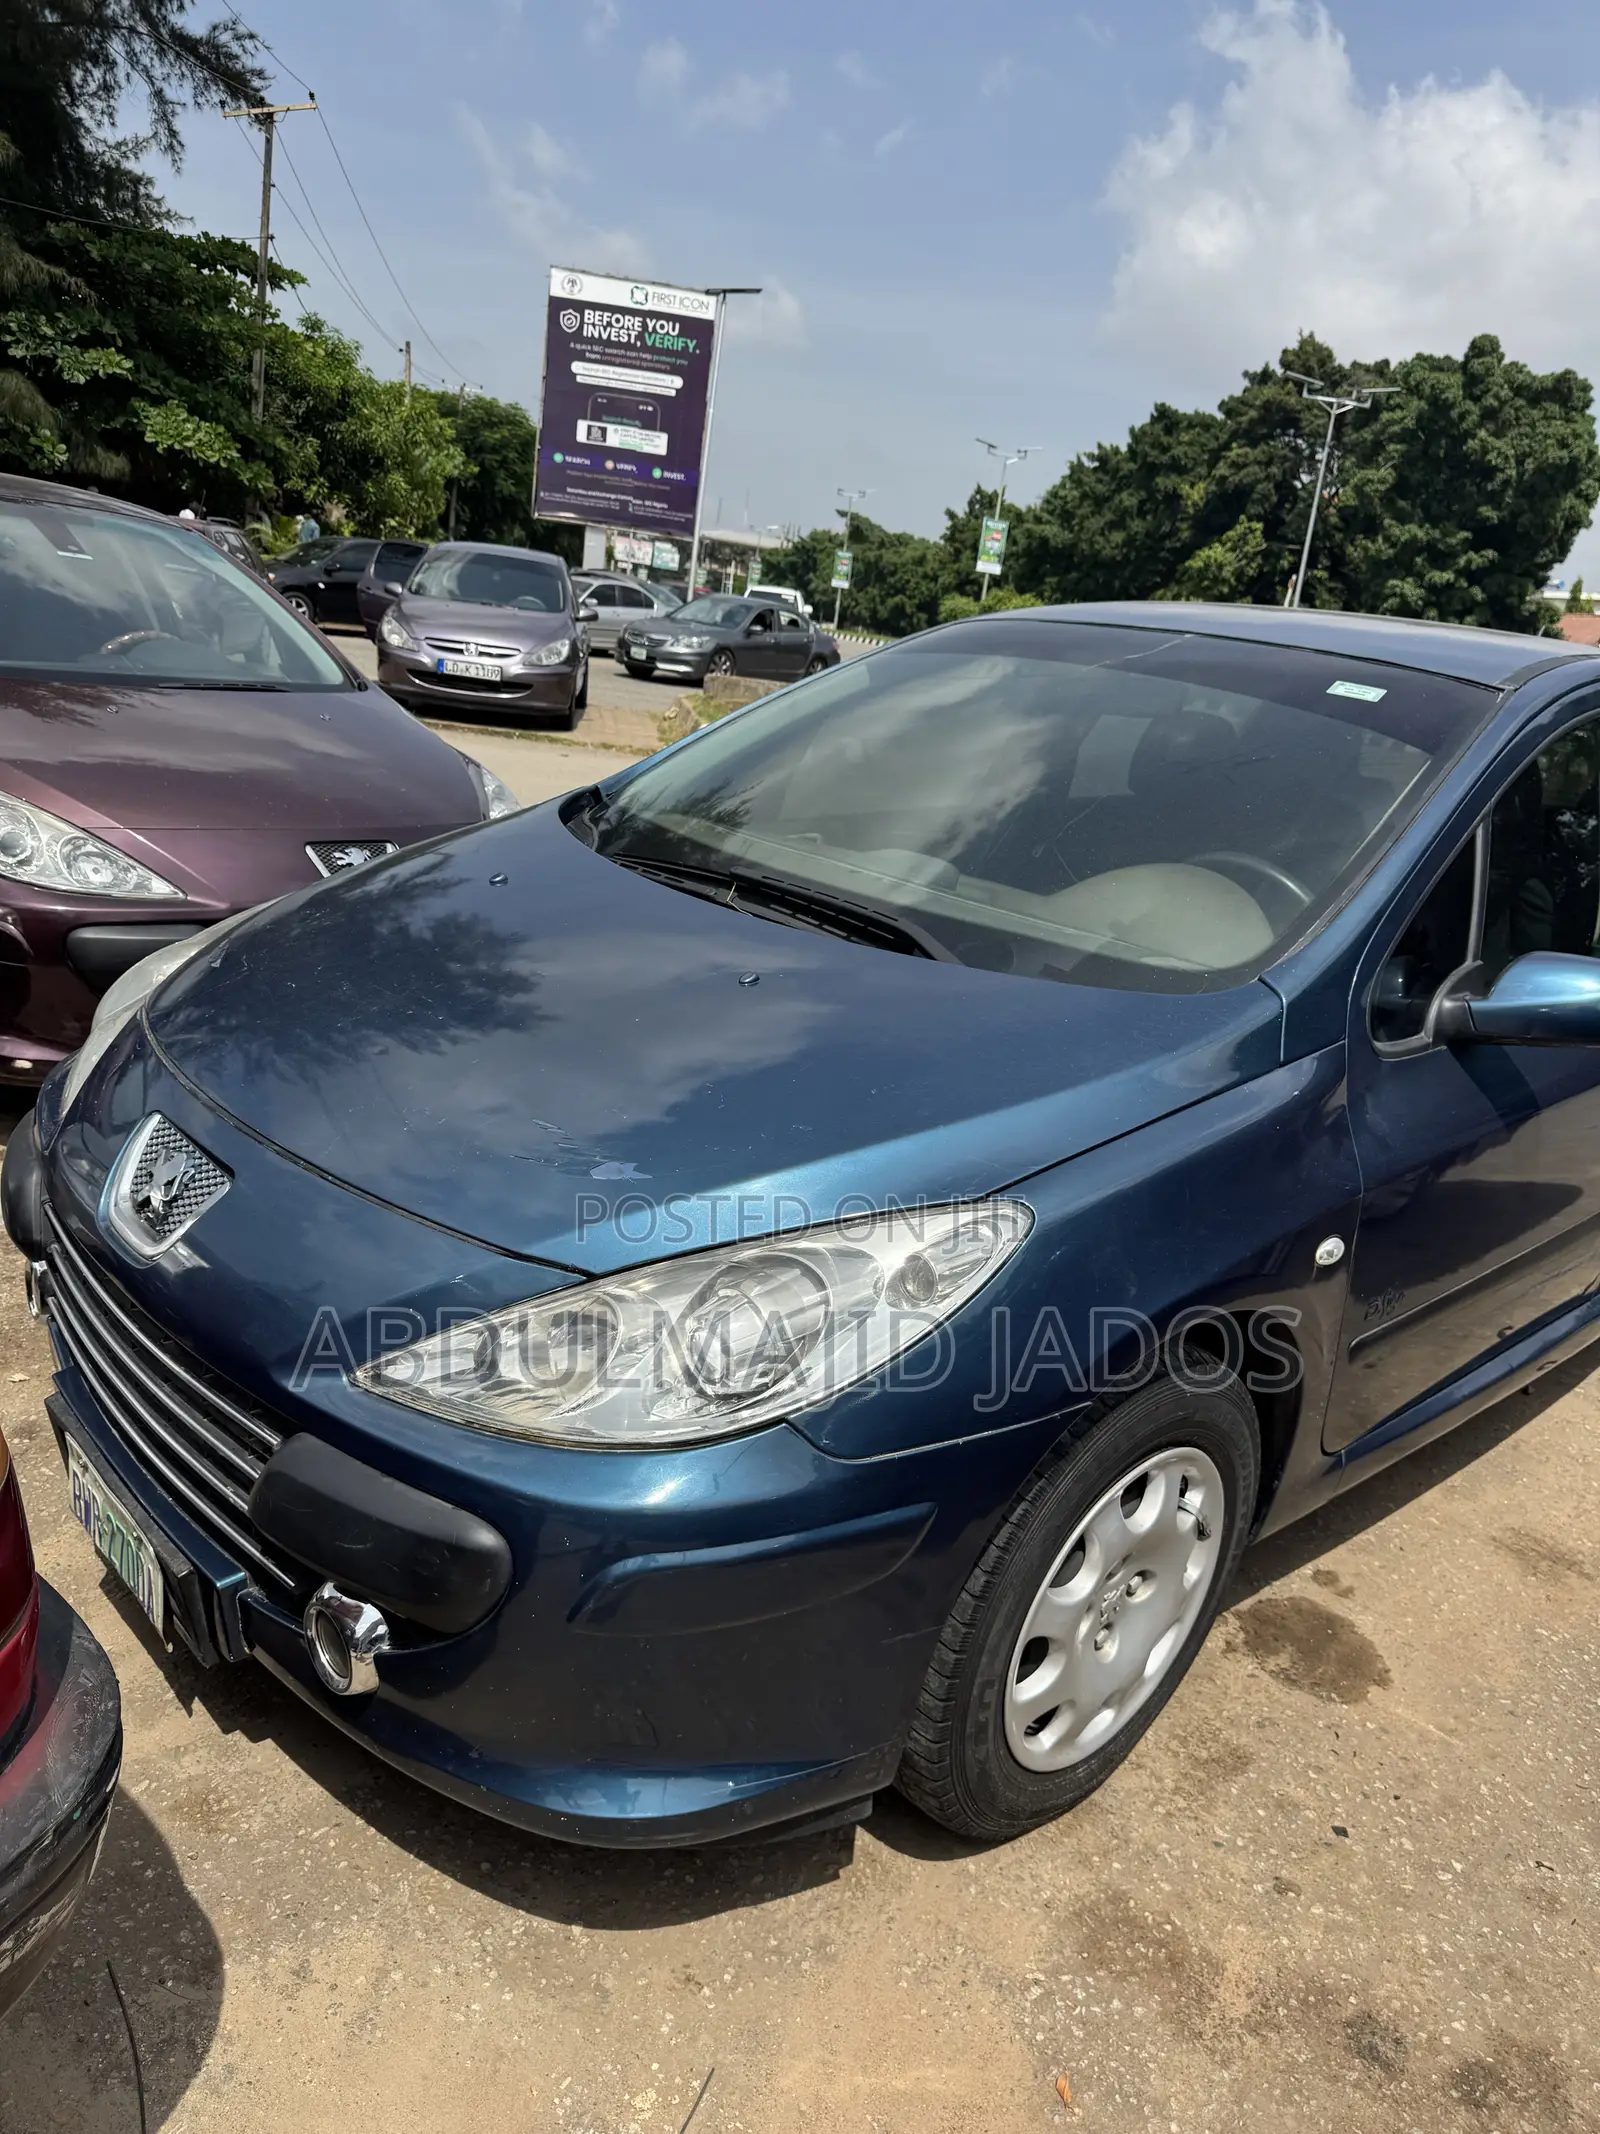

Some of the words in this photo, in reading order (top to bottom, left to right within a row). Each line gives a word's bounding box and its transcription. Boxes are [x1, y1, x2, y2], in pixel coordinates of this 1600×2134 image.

[652, 291, 677, 305] FIRST
[679, 296, 710, 312] ICON
[584, 309, 643, 332] BEFORE
[646, 317, 680, 336] YOU
[583, 324, 641, 347] INVEST,
[645, 332, 700, 354] VERIFY.
